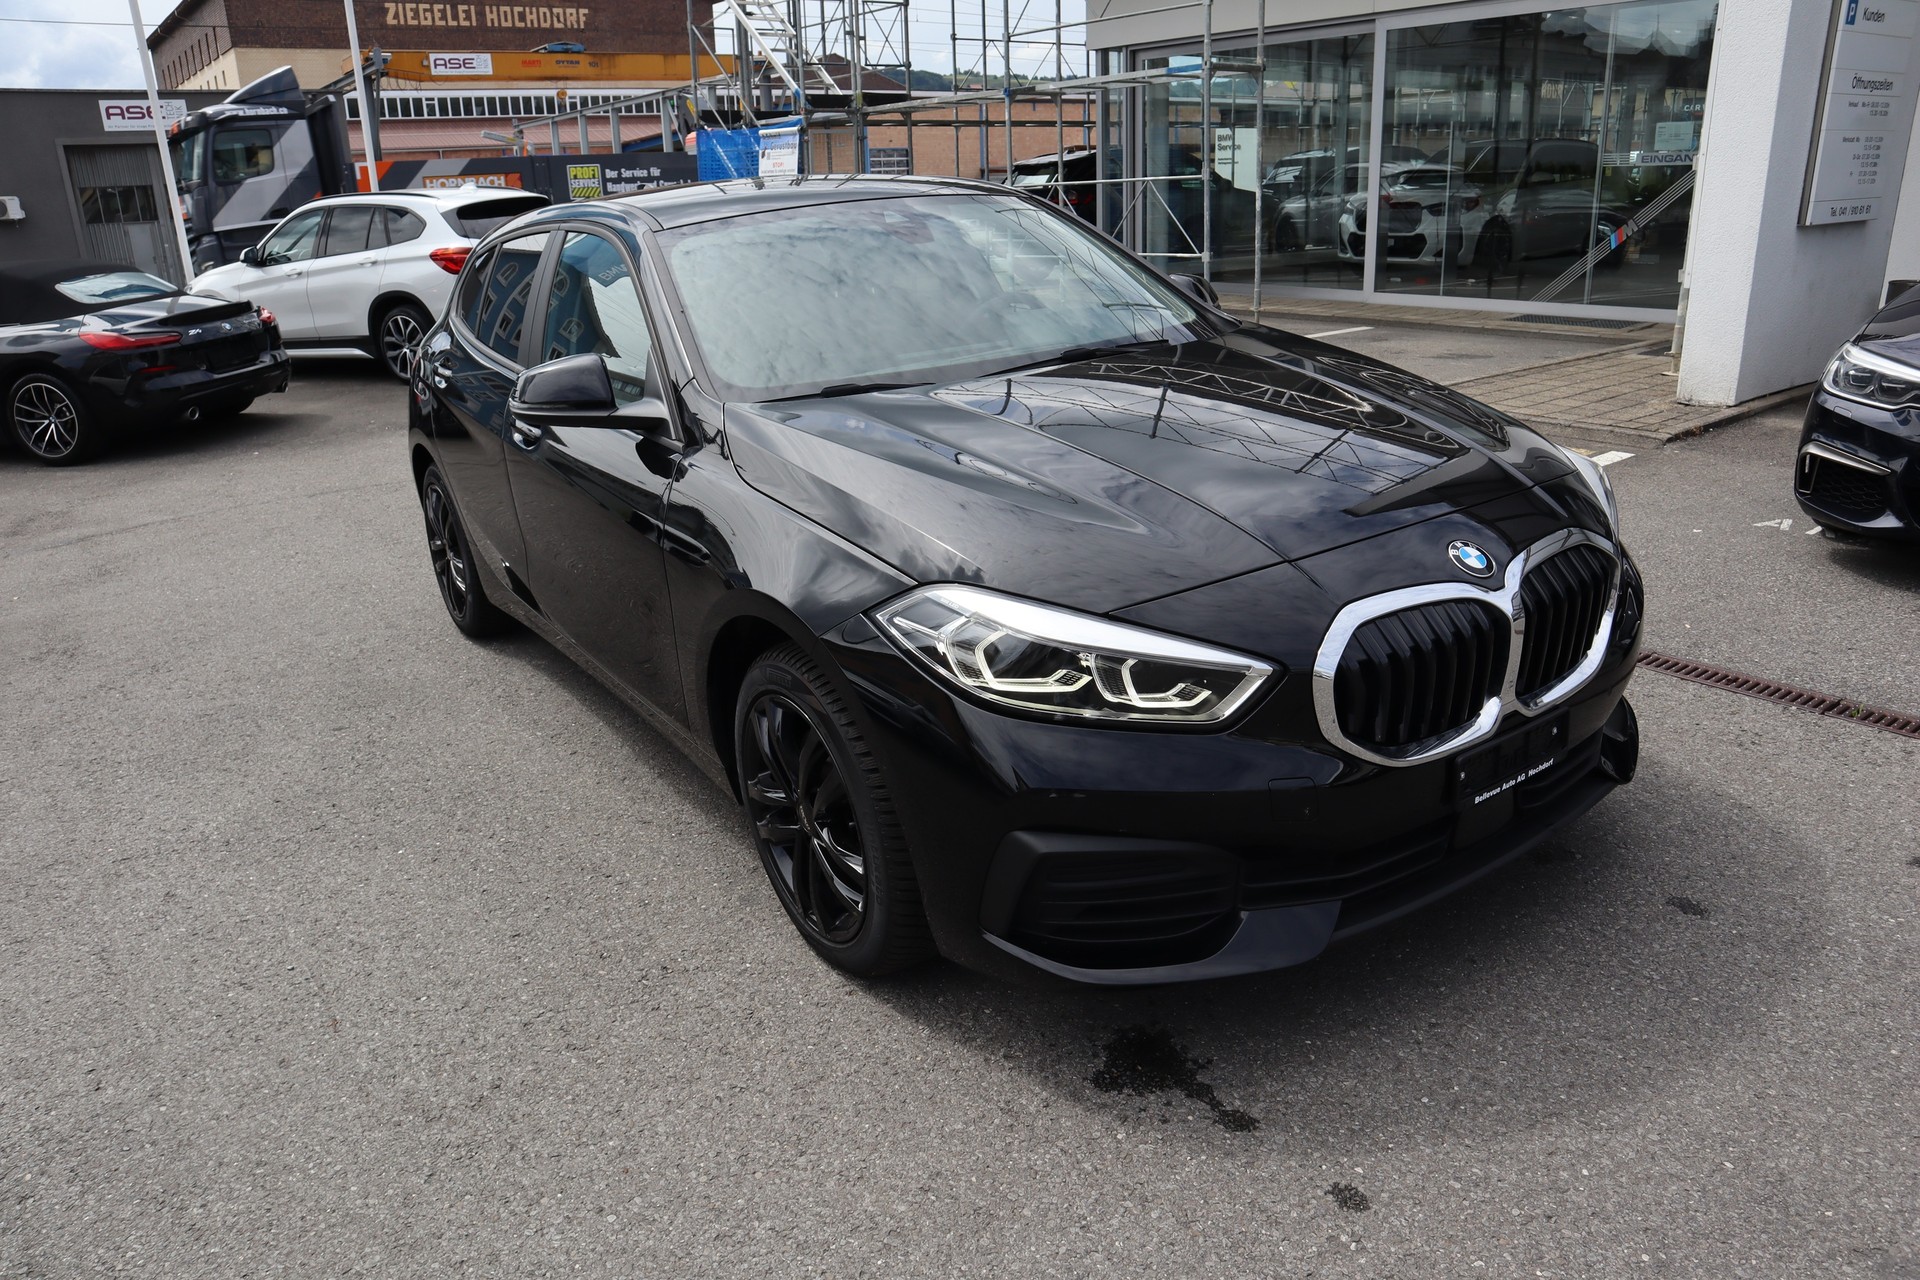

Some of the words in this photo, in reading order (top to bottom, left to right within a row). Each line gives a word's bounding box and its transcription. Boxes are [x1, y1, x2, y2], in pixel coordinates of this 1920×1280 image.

[384, 3, 477, 26] ZIEGELEI
[485, 5, 589, 29] HOCHDORF
[1863, 7, 1885, 23] Kunden
[433, 57, 476, 69] ASE
[1851, 72, 1893, 92] Öffnungszeiten
[1217, 143, 1242, 151] Servce
[1641, 154, 1694, 163] EINGAN
[569, 166, 599, 179] PROFI
[605, 169, 618, 178] Der
[621, 168, 648, 178] Service
[649, 167, 661, 177] für
[570, 178, 600, 188] SERVICE
[1474, 787, 1501, 804] Bellevue
[1502, 779, 1516, 791] Auto
[1517, 773, 1526, 784] AG
[1528, 758, 1554, 777] Hochdorf
